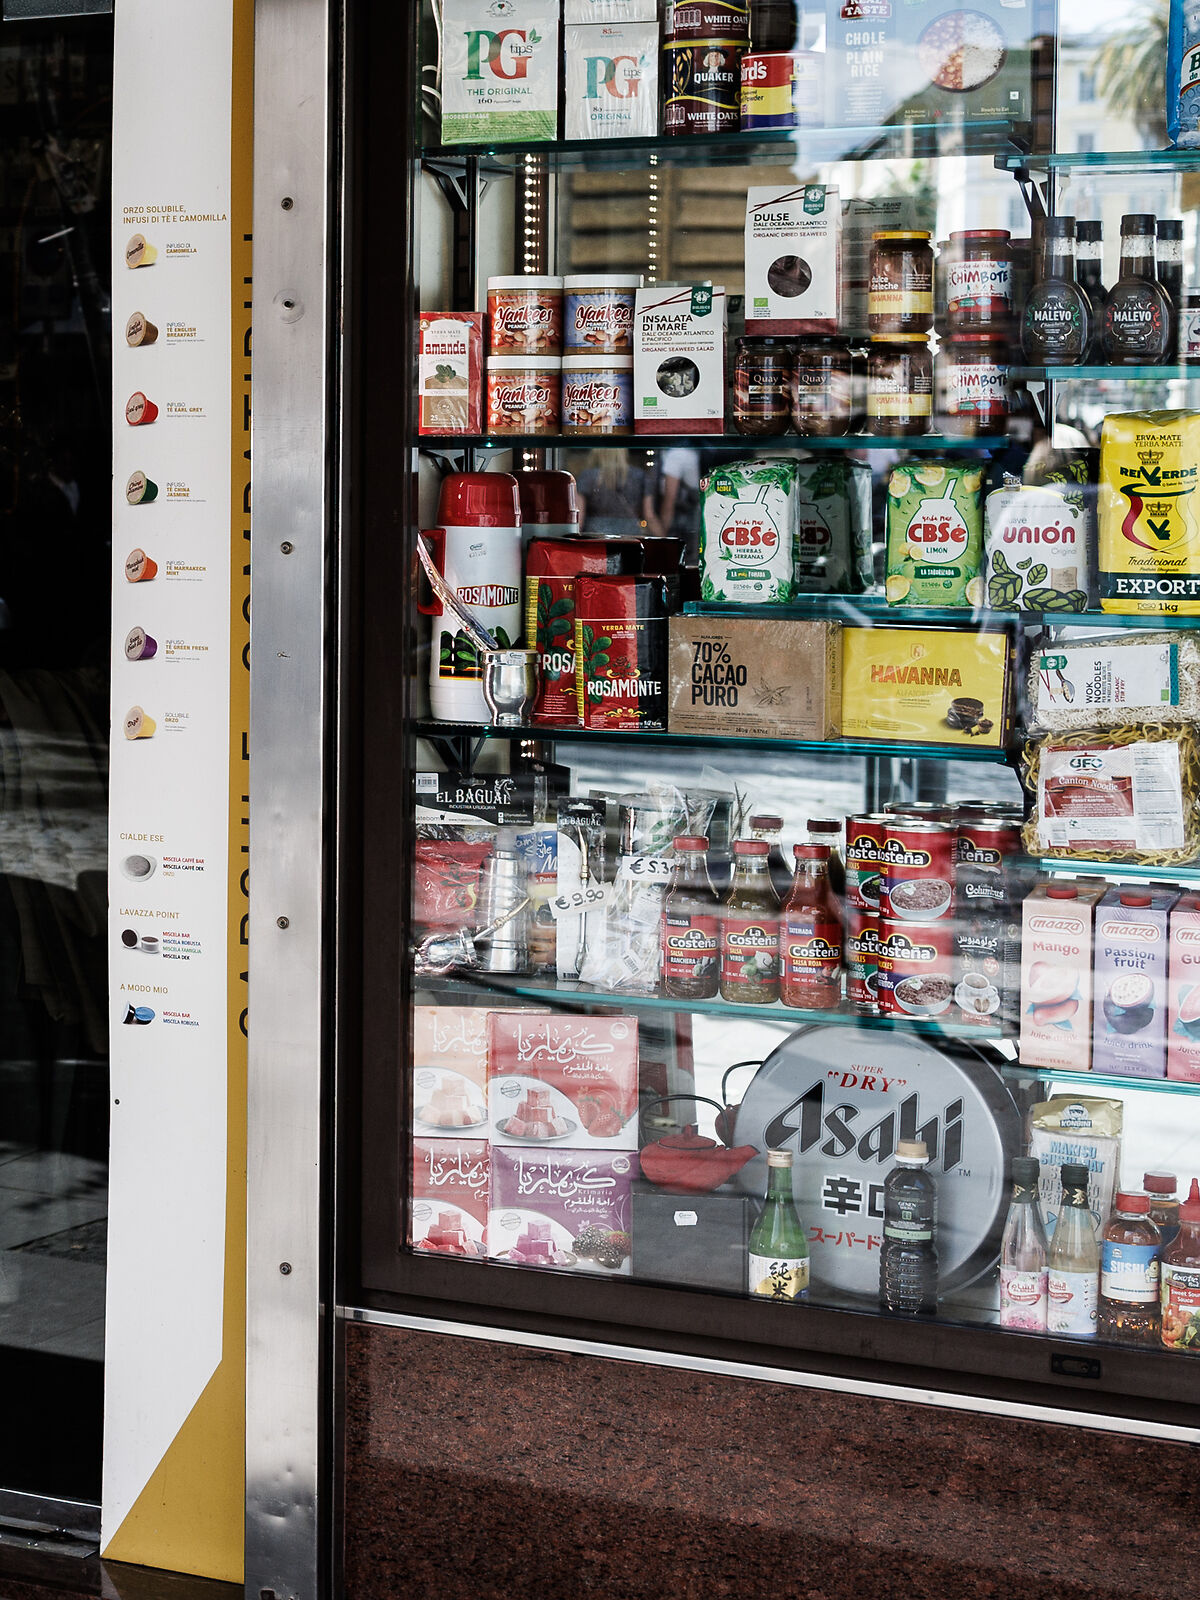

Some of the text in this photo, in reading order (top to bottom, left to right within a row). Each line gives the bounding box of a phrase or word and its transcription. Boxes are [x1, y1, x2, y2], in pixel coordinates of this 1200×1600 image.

[844, 5, 888, 16] TASTE
[704, 16, 732, 24] WHITE
[845, 32, 886, 46] CHOLE
[462, 30, 533, 80] PG
[510, 43, 533, 56] tips
[846, 51, 884, 64] PLAIN
[582, 56, 641, 99] PG
[850, 64, 880, 78] RICE
[694, 72, 734, 84] QUAKER
[467, 87, 533, 96] THE ORIGINAL
[687, 112, 739, 121] WHITE OATS
[123, 206, 144, 214] ORZO
[123, 216, 150, 224] INFUSI
[180, 214, 227, 222] CAMOMILLA
[754, 213, 790, 222] DULSE
[496, 304, 553, 332] Yankees
[576, 304, 634, 330] Yankees
[642, 314, 694, 324] INSALATA
[1034, 310, 1072, 323] MALEVO
[1113, 310, 1152, 323] MALEVO
[642, 322, 688, 332] DI MARE
[425, 340, 466, 354] amanda
[754, 374, 778, 384] Quay
[802, 374, 827, 384] Quay
[493, 384, 550, 409] Yankees
[564, 383, 620, 408] Yankees
[590, 402, 622, 410] Crunchy
[722, 527, 778, 546] CBSé
[908, 524, 966, 543] CBSé
[1128, 556, 1188, 566] Tradicional
[456, 586, 518, 606] ROSAMONTE
[1158, 602, 1178, 612] 1kg
[692, 642, 731, 664] 70%
[692, 664, 747, 686] CACAO
[871, 664, 962, 687] HAVANNA
[1094, 660, 1102, 704] NOODLES
[588, 680, 662, 698] ROSAMONTE
[692, 686, 738, 708] PURO
[1070, 758, 1103, 768] UFC
[1058, 776, 1118, 790] Canton Noodle
[436, 788, 511, 804] EL BAGUAL
[120, 832, 164, 842] CIALDE ESE
[860, 836, 872, 848] La
[888, 841, 898, 852] La
[965, 884, 1004, 900] Columbus
[120, 908, 180, 920] LAVAZZA POINT
[1032, 919, 1080, 932] maaza
[1106, 924, 1155, 937] maaza
[690, 932, 700, 940] La
[750, 929, 760, 937] La
[670, 938, 716, 948] Costeña
[730, 936, 777, 946] Costeña
[892, 936, 905, 946] La
[792, 947, 839, 958] Costeña
[1032, 942, 1080, 956] Mango
[1114, 958, 1146, 970] fruit
[128, 984, 168, 994] MODO MIO
[850, 1064, 884, 1074] SUPER
[763, 1079, 964, 1174] Asahi
[1061, 1120, 1092, 1128] KONBINI
[1050, 1141, 1097, 1160] MAKISU
[808, 1226, 884, 1250] スーパード
[1110, 1261, 1145, 1274] SUSHI
[768, 1261, 793, 1299] 純米
[1171, 1288, 1187, 1296] Sweet
